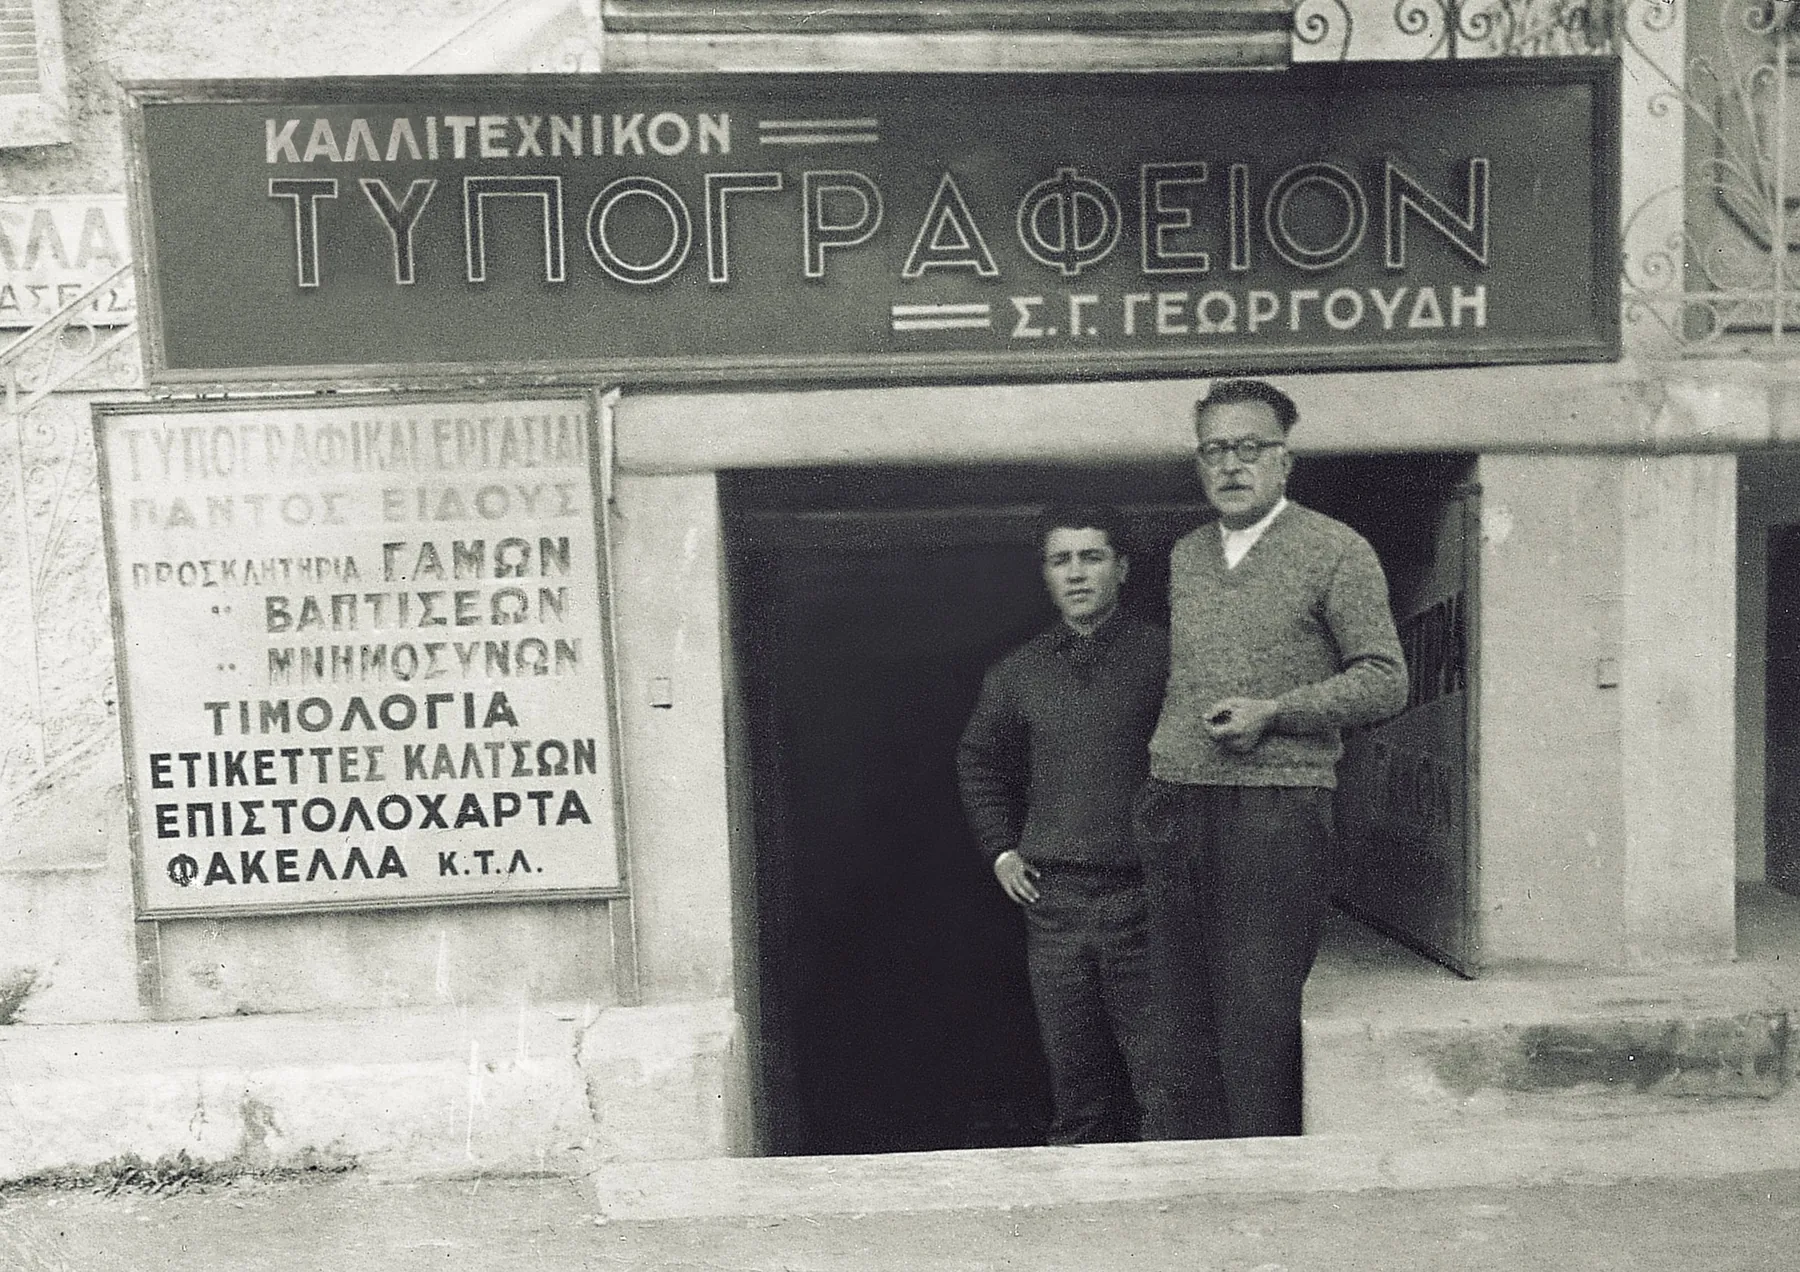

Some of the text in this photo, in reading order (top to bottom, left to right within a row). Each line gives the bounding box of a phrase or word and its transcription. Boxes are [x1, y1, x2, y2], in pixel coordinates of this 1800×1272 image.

[265, 112, 731, 163] ΚΑΛΛΙΤΕΧΝΙΚΟΝ
[267, 157, 1490, 287] ΤΥΠΟΓΡΑΦΕΙΟΝ
[1124, 286, 1488, 335] ΓΕΩΡΓΟΥΔΗ
[119, 414, 584, 482] ΤΥΠΟΓΡΑΦΙΚΑΙ ΕΡΓΑΣΙΑΙ
[129, 483, 581, 530] ΠΑΝΤΟΣ ΕΙΔΟΥΣ
[132, 537, 571, 588] ΠΡΟΣΚΛΗΤΗΡΙΑ ΓΑΜΩΝ
[265, 587, 570, 633] ΒΑΠΤΙΣΕΩΝ
[267, 637, 582, 685] ΜΝΗΜΟΣΥΝΩΝ
[204, 691, 519, 736] ΤΙΜΟΛΟΓΙΑ
[150, 738, 597, 789] ΕΤΙΚΕΤΤΕΣ ΚΑΛΤΣΩΝ
[156, 789, 592, 839] ΕΠΙΣΤΟΛΟΧΑΡΤΑ
[166, 845, 408, 888] ΦΑΚΕΛΛΑ
